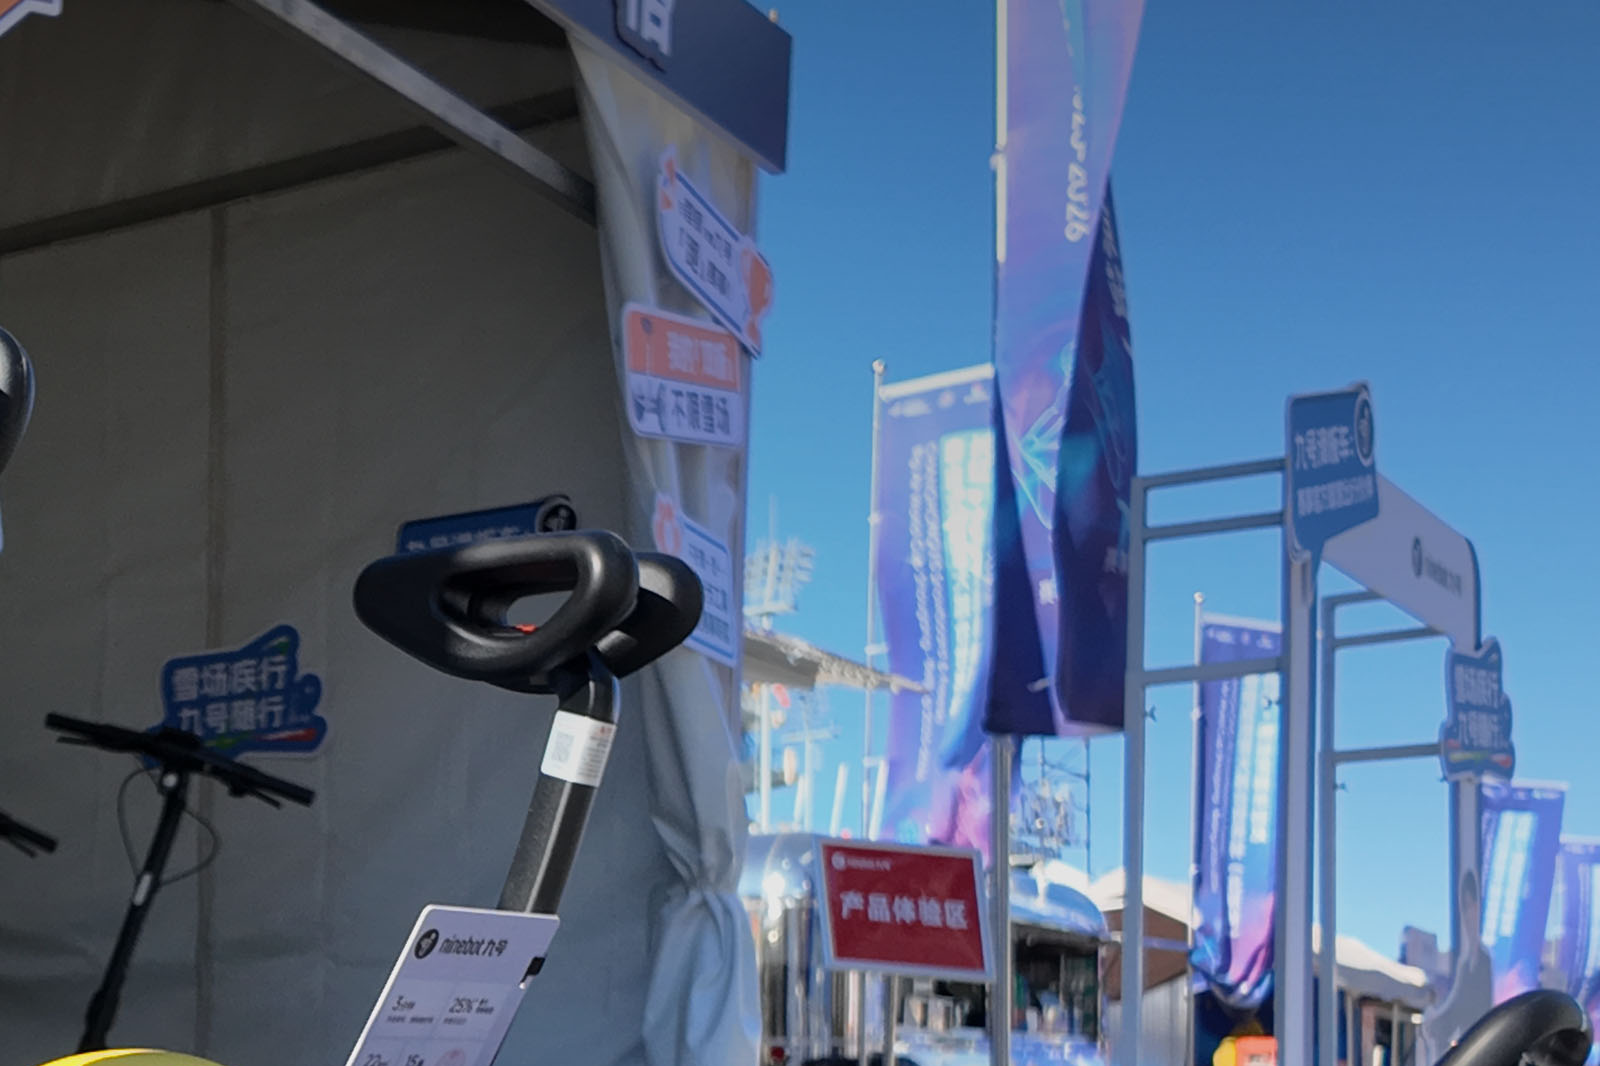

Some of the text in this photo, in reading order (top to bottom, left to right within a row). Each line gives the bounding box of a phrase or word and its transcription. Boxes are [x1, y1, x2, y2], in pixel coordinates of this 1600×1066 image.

[172, 653, 288, 700] 雪场疾行
[178, 696, 284, 736] 九号随行
[840, 888, 968, 930] 产品体验区
